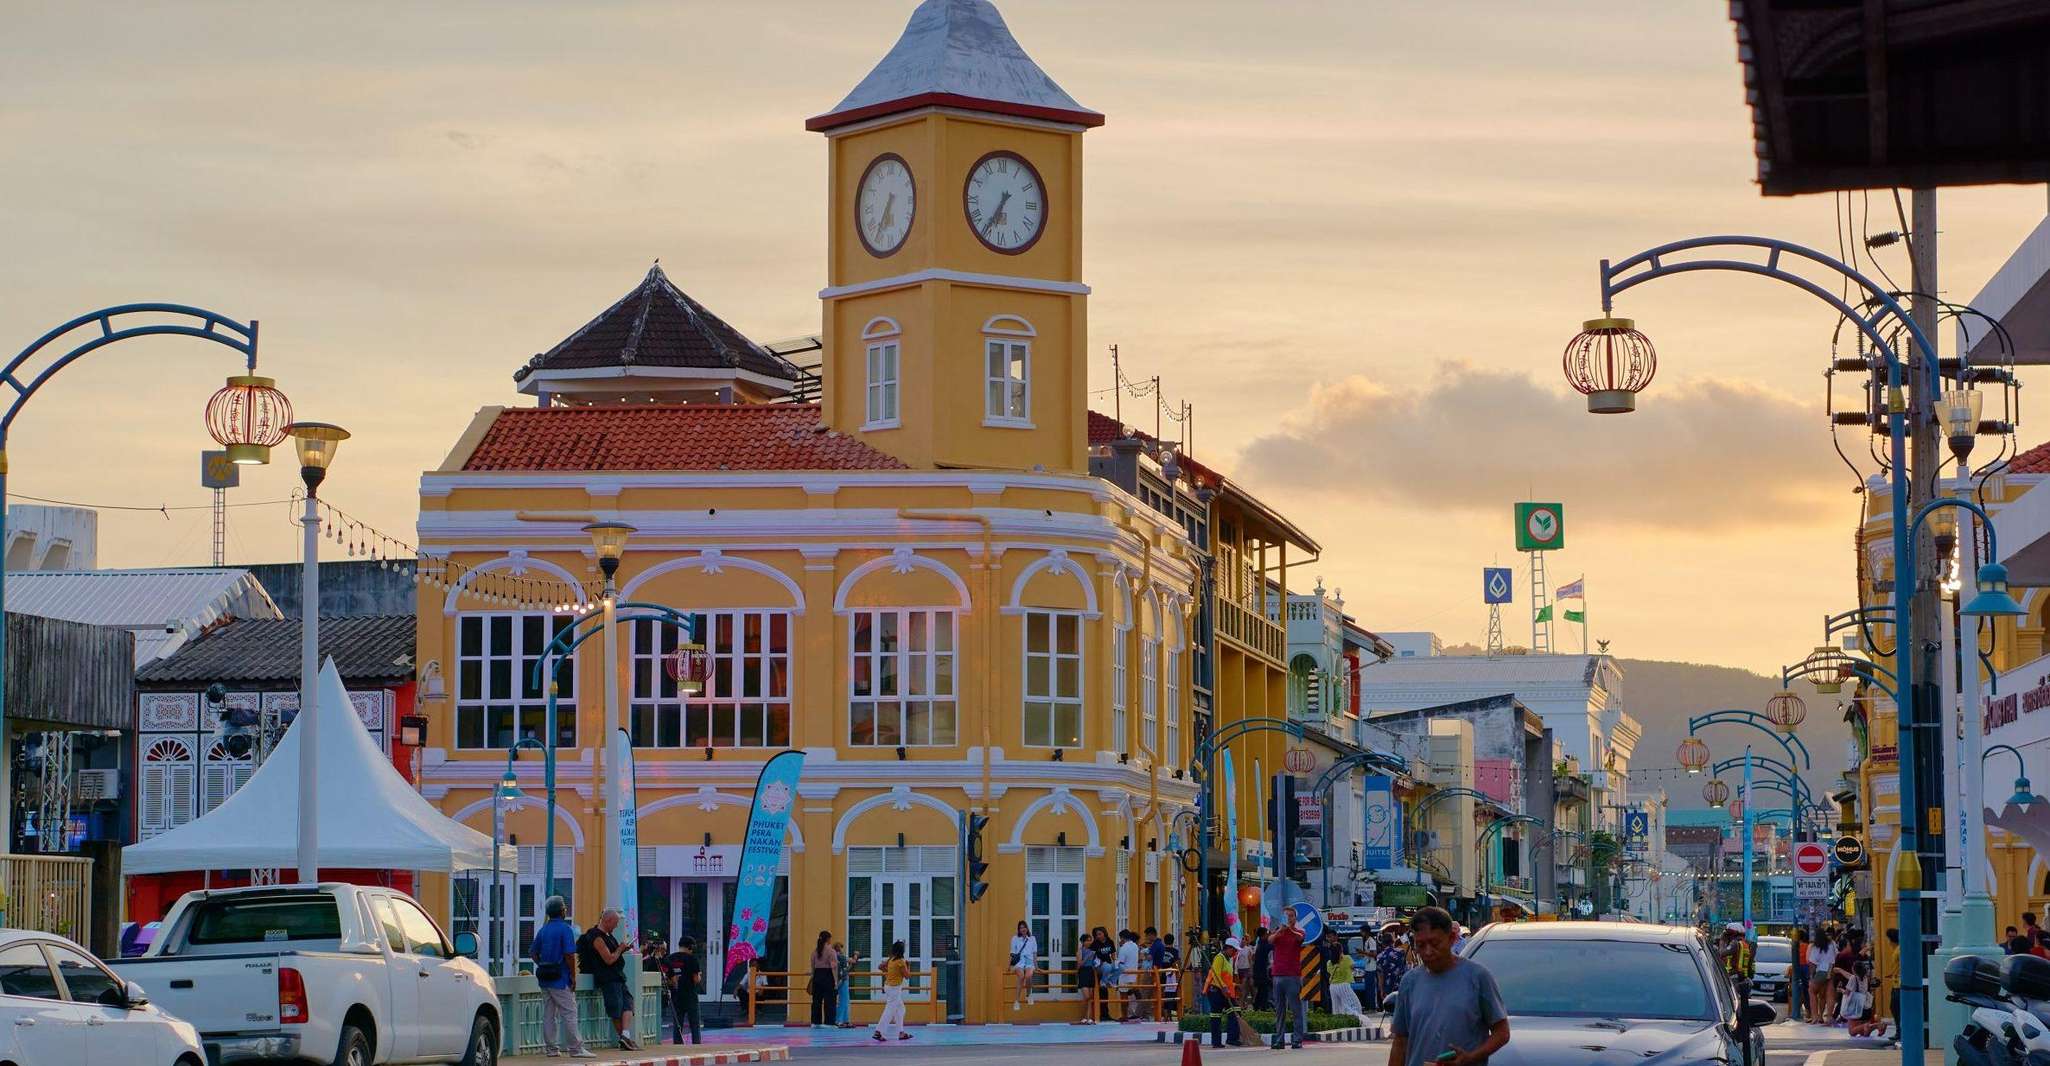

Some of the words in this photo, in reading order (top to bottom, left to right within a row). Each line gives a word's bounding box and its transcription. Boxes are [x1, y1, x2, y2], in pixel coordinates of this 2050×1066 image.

[997, 159, 1007, 174] XII
[1022, 183, 1033, 192] II
[1025, 201, 1038, 210] III
[753, 821, 784, 830] PHUKET
[750, 838, 780, 847] NAKAN
[1797, 879, 1826, 889] ห้ามเข้า
